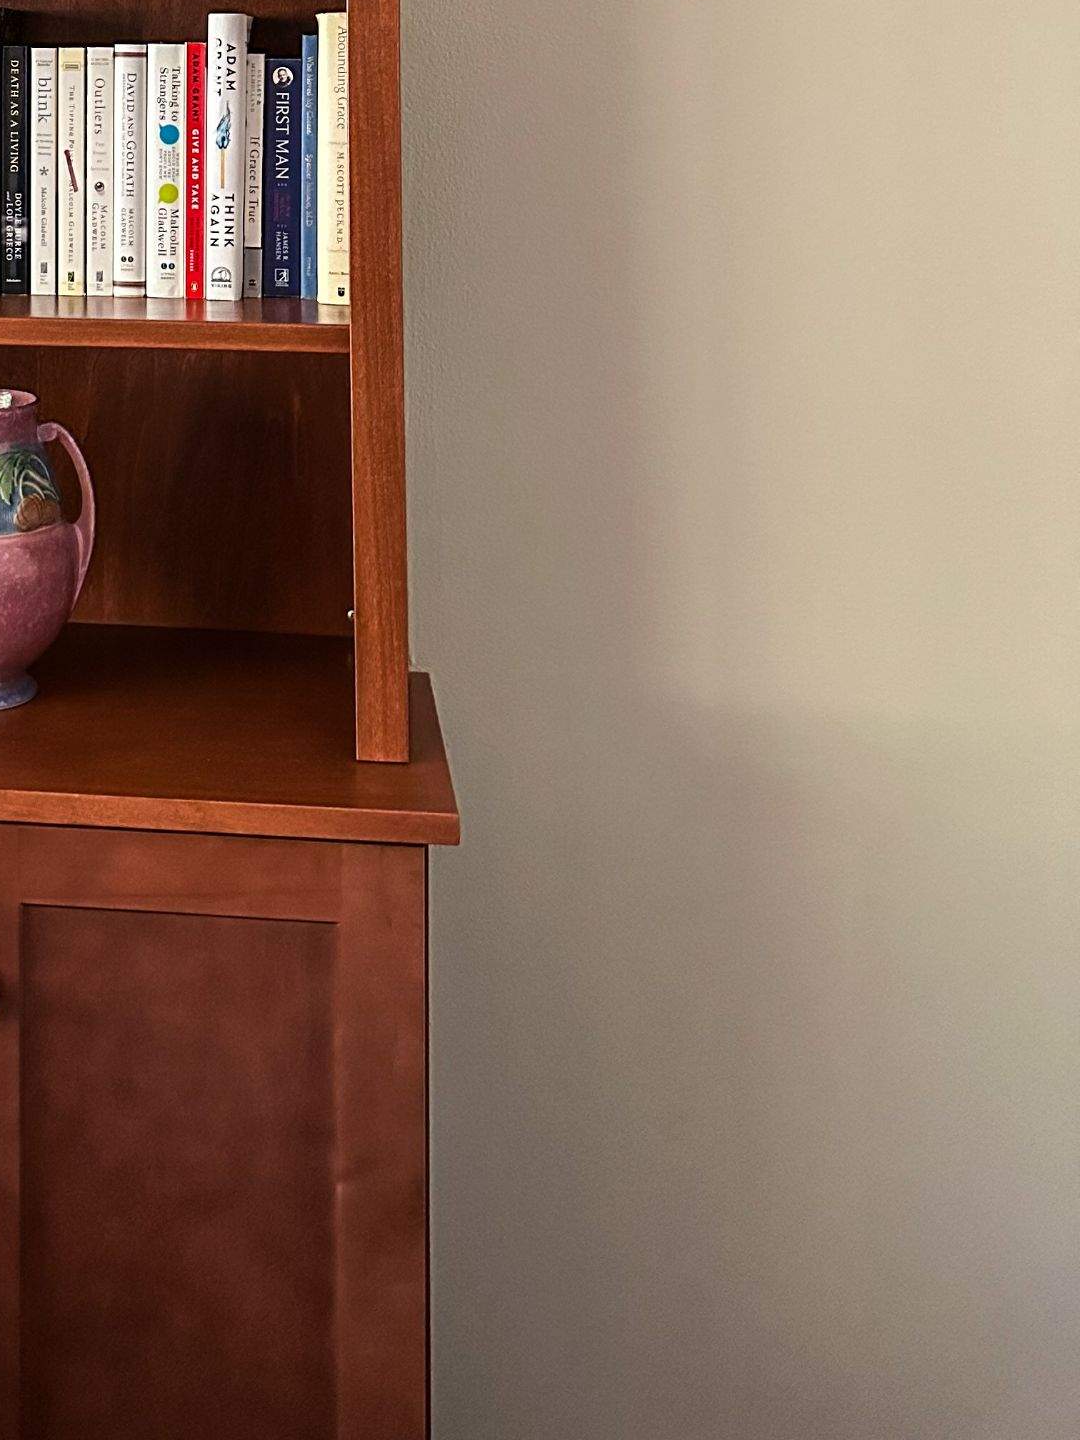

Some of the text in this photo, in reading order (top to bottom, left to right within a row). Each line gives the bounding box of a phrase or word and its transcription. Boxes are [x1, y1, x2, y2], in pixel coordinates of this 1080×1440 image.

[226, 44, 236, 90] ADAM
[334, 26, 348, 130] Abounding Grace
[10, 60, 20, 173] DEATH AS A LIVING
[38, 76, 52, 124] blink
[94, 78, 106, 134] Outliers
[156, 67, 168, 121] Strangers
[169, 66, 181, 122] Talking to
[276, 92, 290, 136] FIRST
[126, 72, 138, 198] DAVID AND GOLIATH
[191, 128, 200, 154] GIVE
[191, 158, 200, 180] AND
[248, 136, 260, 224] If Grace Is True
[276, 140, 290, 180] MAN
[336, 164, 345, 196] SCOTT
[6, 202, 14, 222] LOU
[40, 186, 48, 246] Malcolm Gladwell
[191, 184, 200, 210] TAKE
[210, 194, 220, 248] AGAIN
[224, 194, 234, 248] THINK
[6, 225, 14, 261] GRIECO
[92, 202, 100, 252] GLADWELL
[100, 204, 108, 250] MALCOLM
[158, 208, 168, 256] Gladwell
[169, 208, 180, 256] Malcolm
